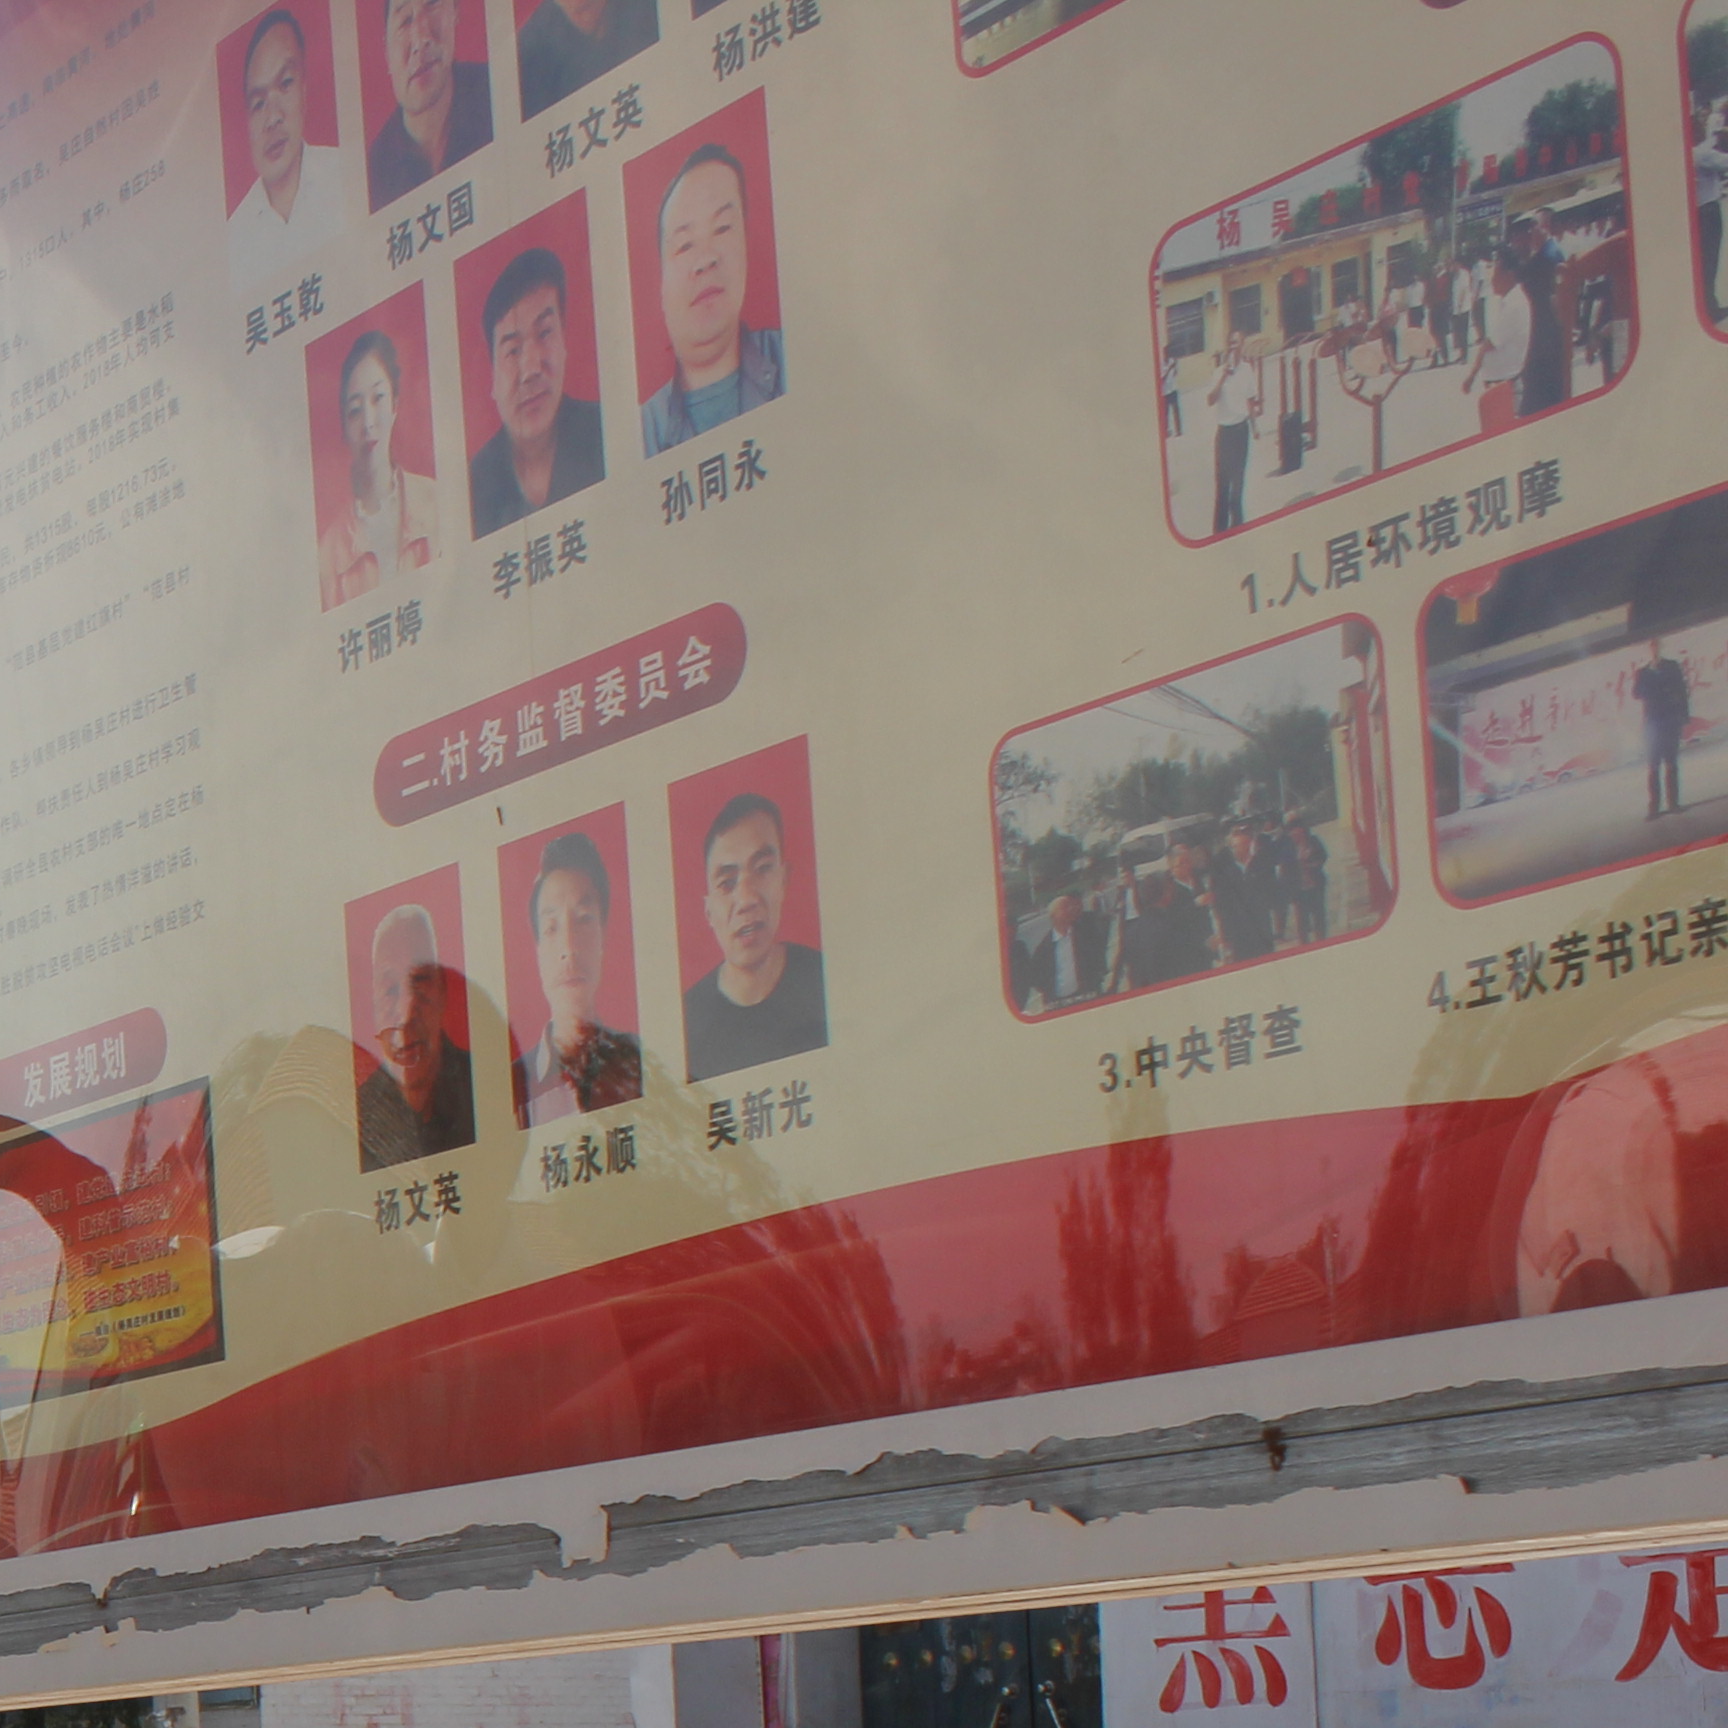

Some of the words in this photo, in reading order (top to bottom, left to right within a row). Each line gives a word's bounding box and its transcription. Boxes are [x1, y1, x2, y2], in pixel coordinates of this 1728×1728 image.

[544, 84, 645, 179] 杨文英
[386, 181, 475, 271] 杨文国
[244, 273, 325, 355] 吴玉乾
[659, 438, 768, 526] 孙同永
[492, 520, 588, 600] 李振英
[1240, 458, 1565, 615] 1.人居环境观摩
[336, 600, 423, 674] 许丽婷
[400, 635, 713, 798] 二.村务监督委员会
[24, 1034, 127, 1108] 发展规划
[1098, 1004, 1304, 1094] 3.中央督查
[706, 1080, 813, 1151] 吴新光
[539, 1125, 638, 1193] 杨永顺
[373, 1171, 462, 1235] 杨文英
